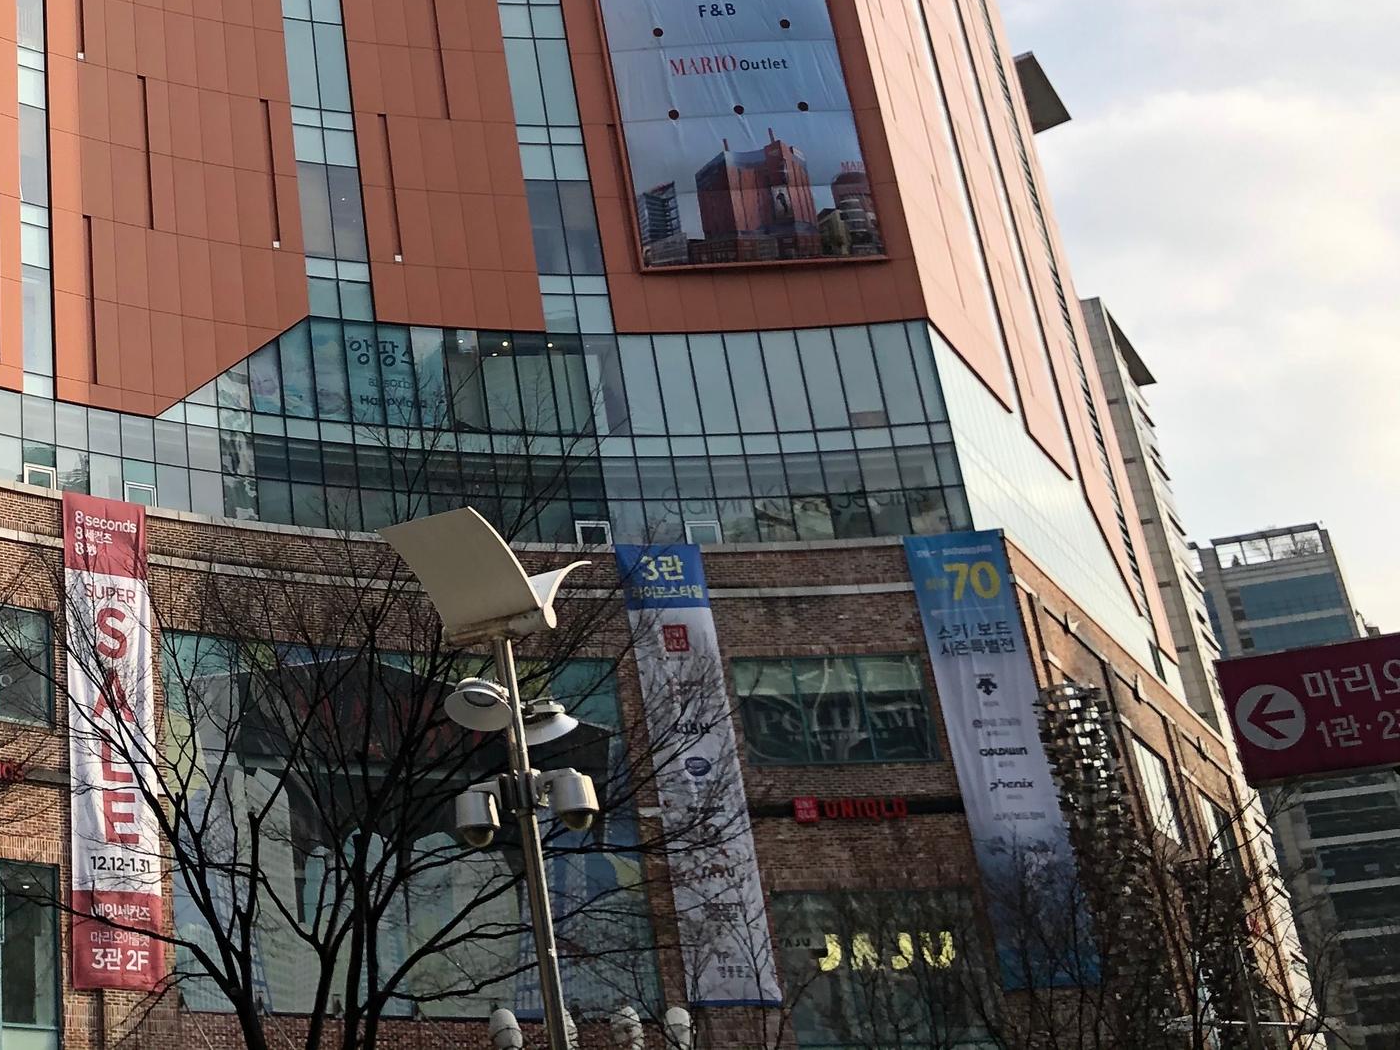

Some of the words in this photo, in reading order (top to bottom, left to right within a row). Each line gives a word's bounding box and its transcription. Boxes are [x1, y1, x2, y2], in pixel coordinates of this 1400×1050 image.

[669, 54, 737, 77] MARIO
[739, 57, 788, 72] Outlet
[85, 514, 137, 534] seconds
[642, 554, 685, 581] 3관
[942, 560, 1000, 601] 70
[84, 583, 136, 605] SUPER
[632, 585, 704, 599] 라이프스타일
[940, 637, 1017, 656] 시즌특별전
[92, 607, 140, 846] SALE
[990, 778, 1034, 792] phenix
[823, 798, 908, 823] UNIQLO
[90, 856, 150, 874] 12.12-1.31
[90, 903, 151, 922] 에잇세컨즈
[90, 931, 150, 948] 마리오아울렛
[91, 947, 123, 972] 3관
[125, 949, 149, 971] 2F
[818, 931, 956, 972] JAJU
